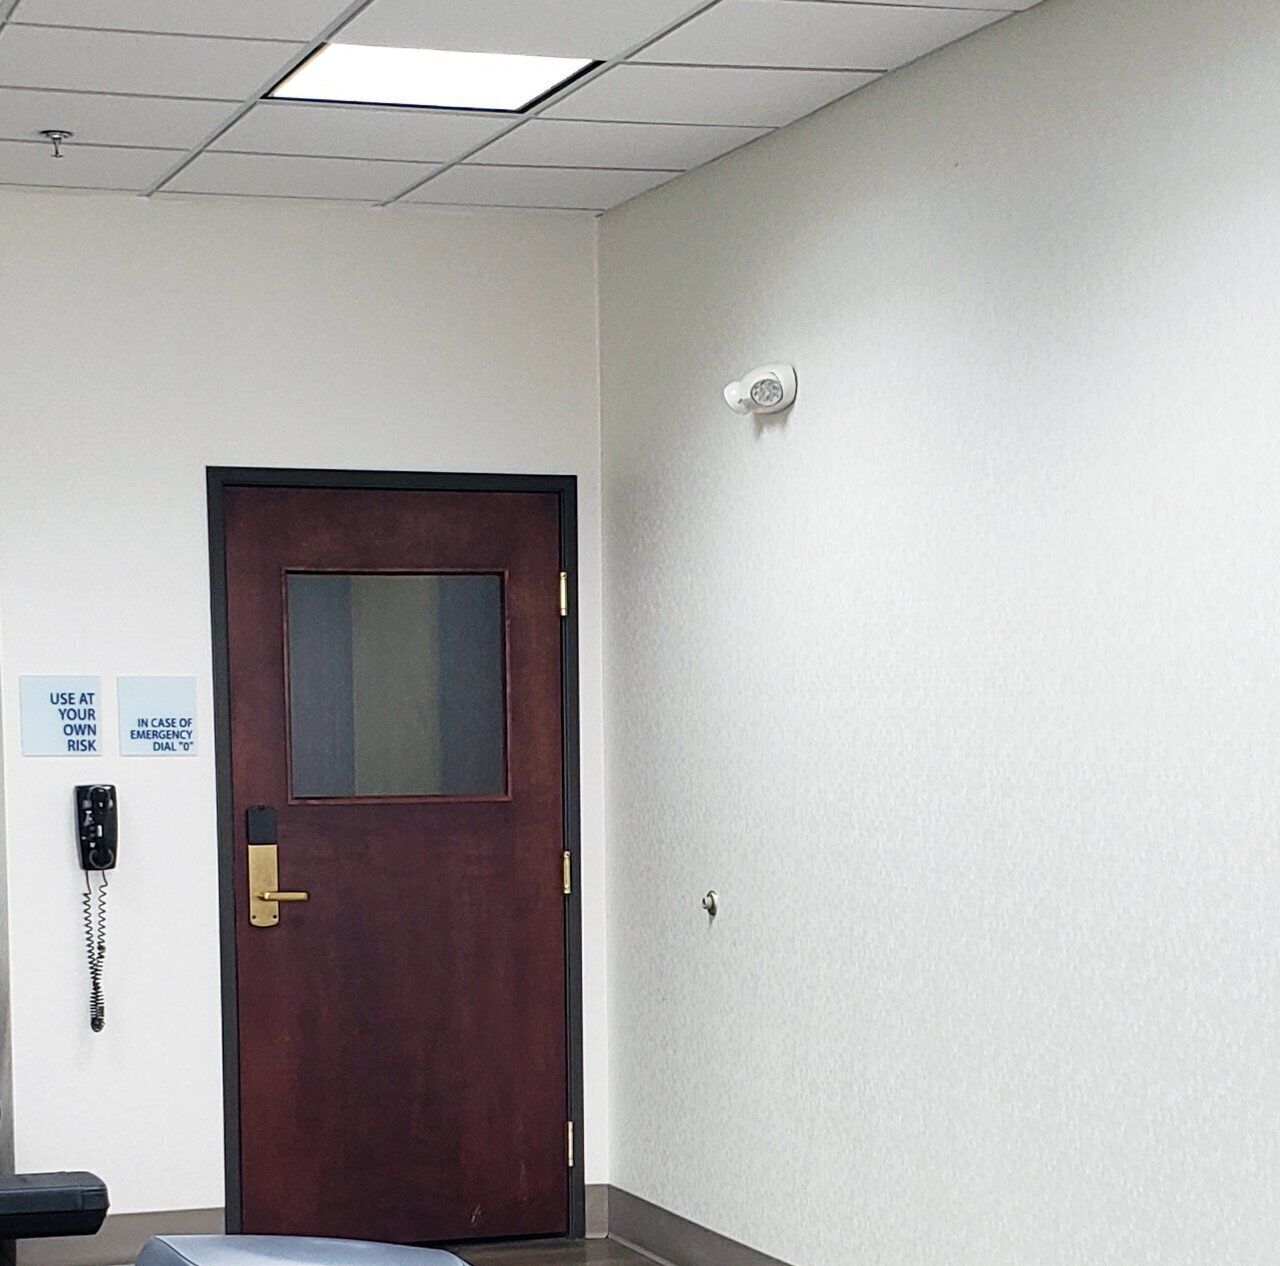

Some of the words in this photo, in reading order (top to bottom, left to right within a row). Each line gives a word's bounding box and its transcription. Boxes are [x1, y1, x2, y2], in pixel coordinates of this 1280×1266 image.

[50, 692, 75, 705] USE
[79, 692, 95, 705] AT
[58, 708, 96, 721] YOUR
[137, 718, 148, 728] IN
[151, 718, 176, 728] CASE
[179, 718, 193, 728] OF
[63, 724, 97, 736] OWN
[130, 730, 193, 740] EMERGENCY
[67, 739, 97, 752] RISK
[153, 741, 176, 751] DIAL
